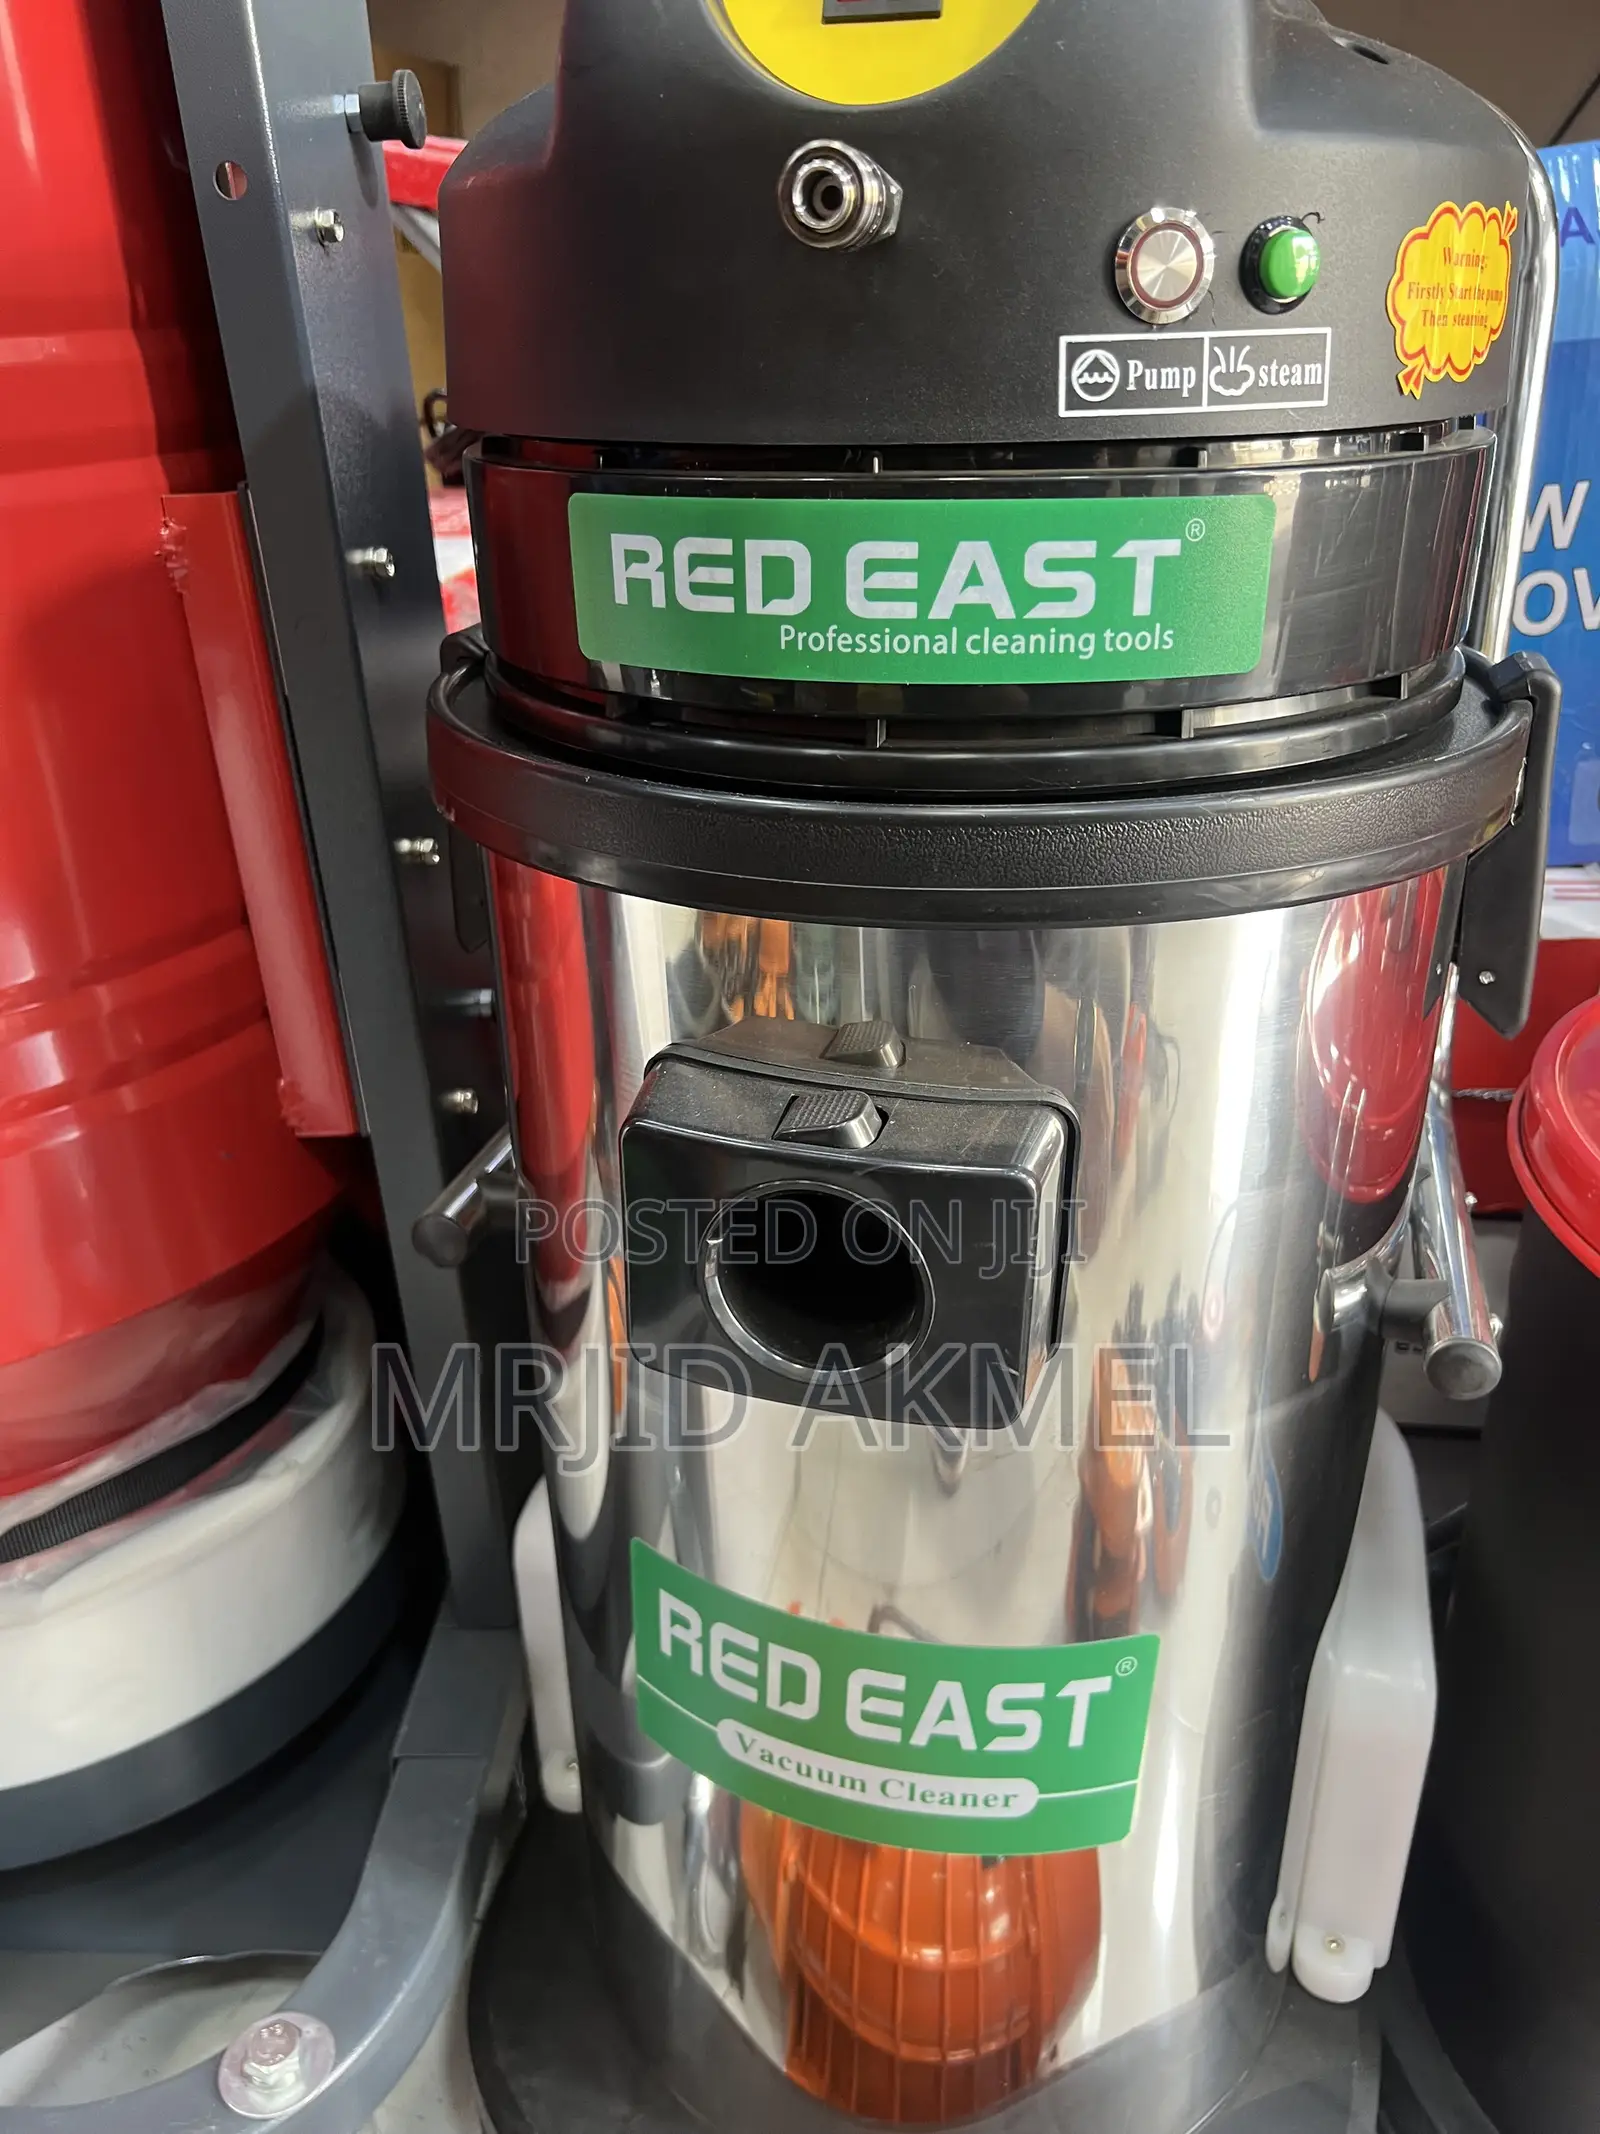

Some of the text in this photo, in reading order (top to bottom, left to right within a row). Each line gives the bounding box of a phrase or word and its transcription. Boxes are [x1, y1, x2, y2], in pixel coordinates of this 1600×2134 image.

[1407, 281, 1503, 307] Firstly Start the pump
[1422, 309, 1448, 327] Then
[1126, 359, 1196, 398] Pump
[1258, 358, 1323, 388] steam
[609, 532, 812, 616] RED
[845, 538, 1182, 620] EAST
[780, 623, 1174, 660] Professional cleaning tools
[658, 1588, 822, 1721] RED
[845, 1667, 1113, 1753] EAST
[734, 1730, 1020, 1810] Vacuum Cleaner
